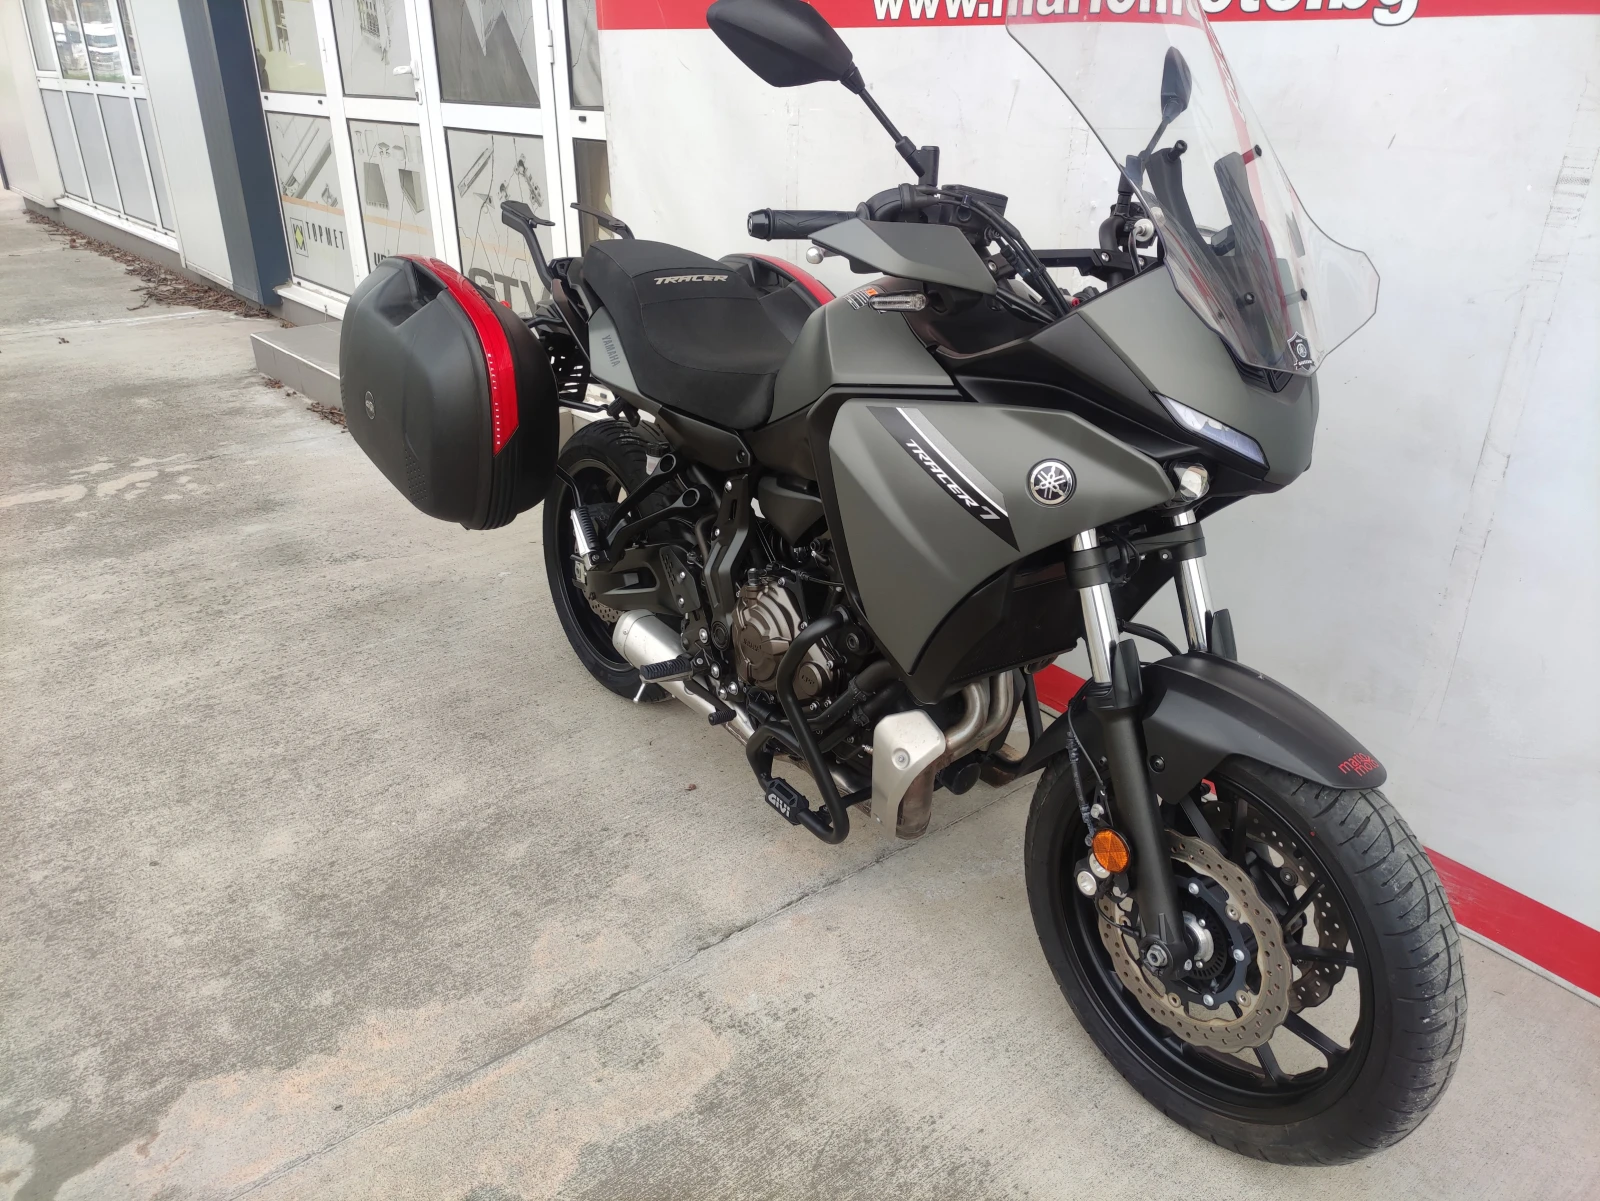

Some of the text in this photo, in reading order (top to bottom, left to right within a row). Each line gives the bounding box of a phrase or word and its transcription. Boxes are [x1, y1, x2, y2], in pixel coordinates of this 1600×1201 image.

[305, 221, 345, 250] TOPMET
[653, 274, 729, 285] TRACER
[602, 334, 621, 368] YAMAHA
[905, 438, 1001, 520] TRACER 7
